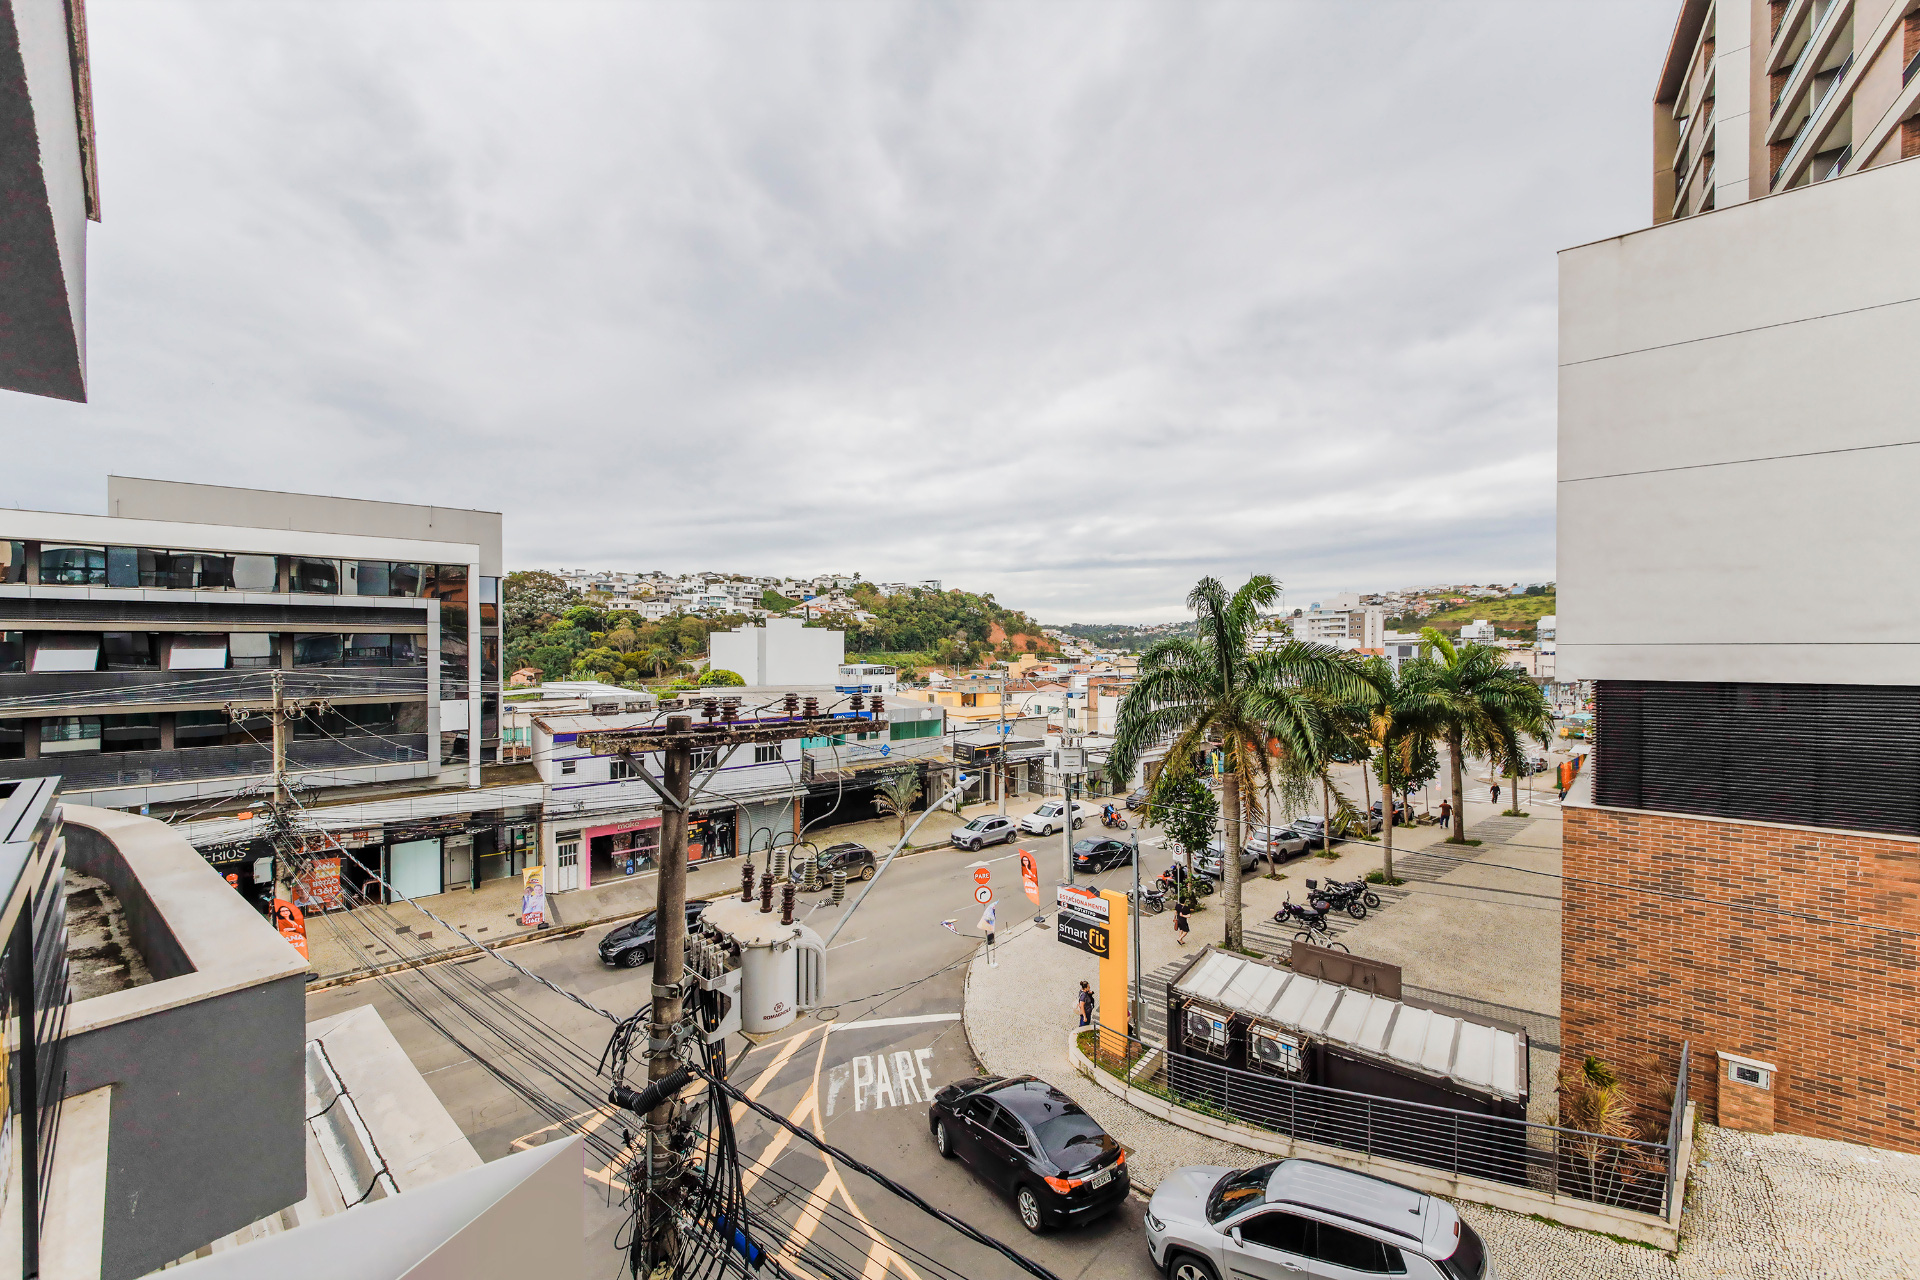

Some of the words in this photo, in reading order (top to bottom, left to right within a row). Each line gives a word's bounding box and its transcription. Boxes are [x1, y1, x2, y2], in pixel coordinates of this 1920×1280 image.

[1059, 893, 1107, 913] ESTACIONAMENTO
[1058, 923, 1088, 941] smart
[1089, 928, 1106, 949] fit
[852, 1048, 937, 1112] PARE
